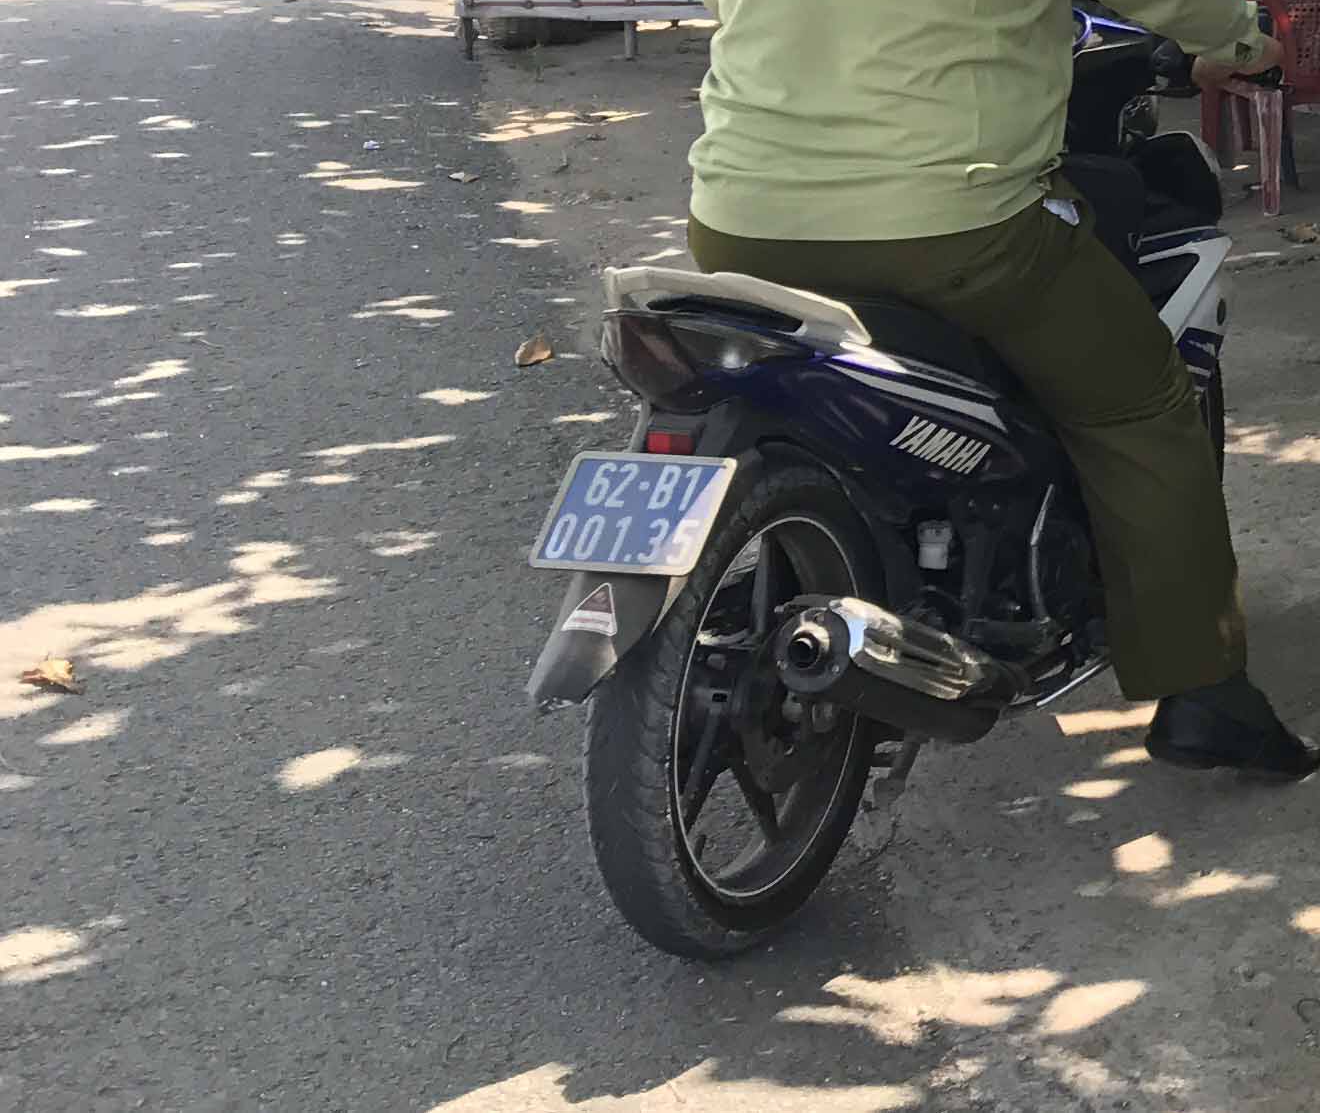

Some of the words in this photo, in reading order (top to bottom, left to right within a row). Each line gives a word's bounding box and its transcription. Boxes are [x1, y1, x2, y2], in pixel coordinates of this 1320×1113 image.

[889, 415, 991, 474] YAMAHA
[584, 462, 702, 511] 62-B1
[545, 513, 699, 565] 001.35
